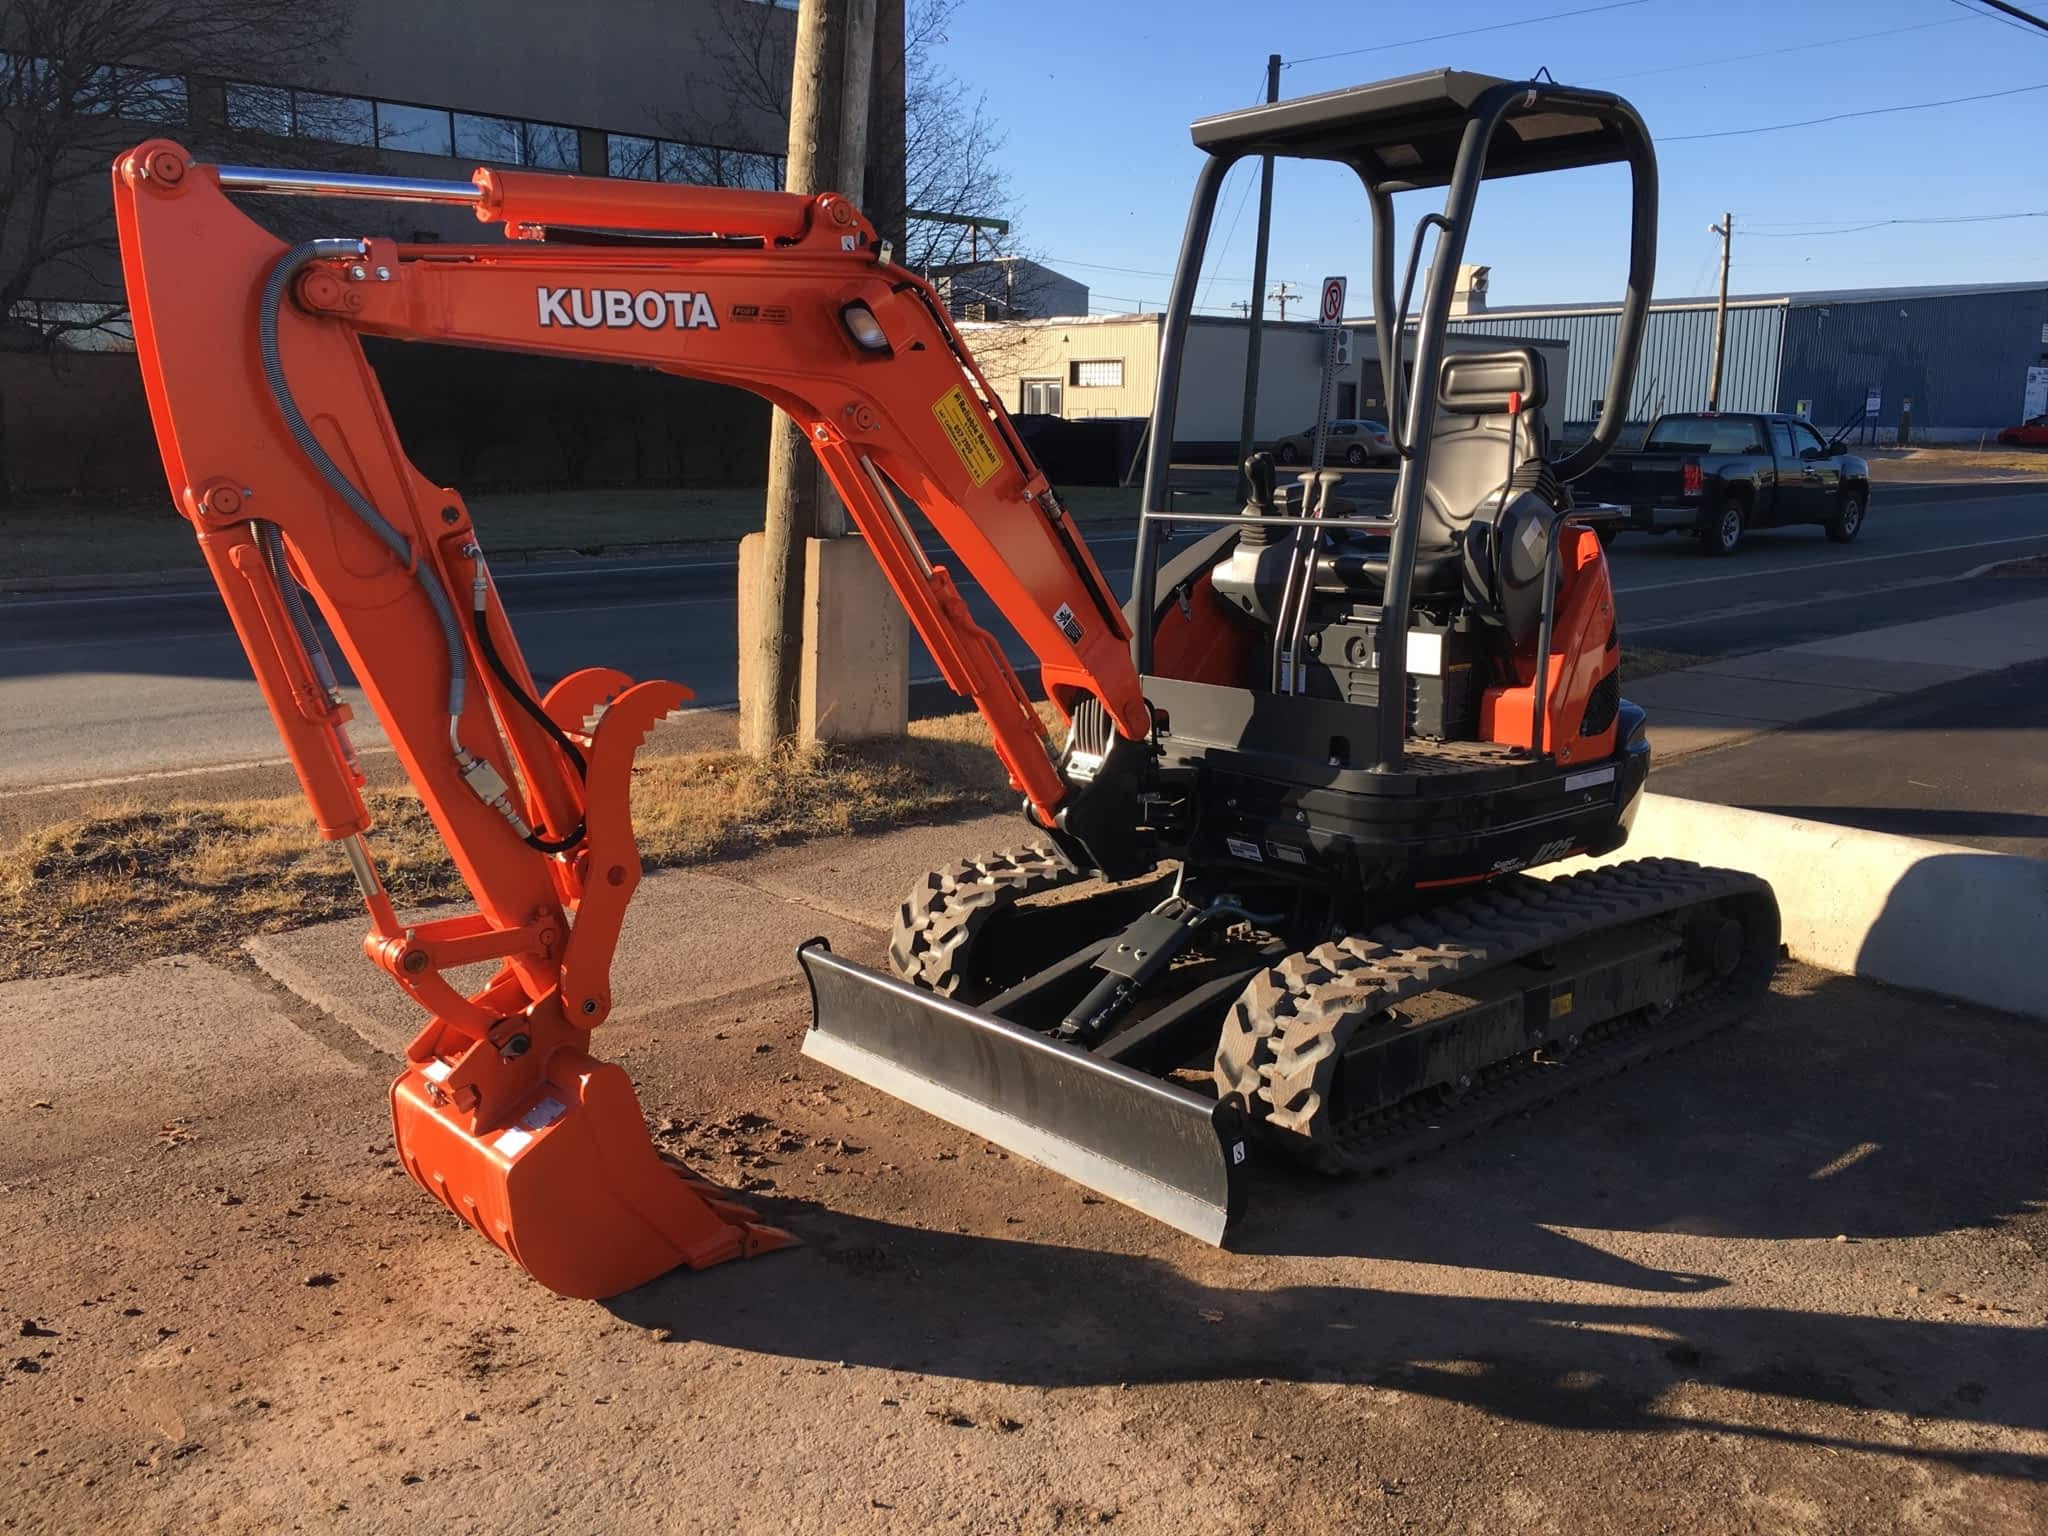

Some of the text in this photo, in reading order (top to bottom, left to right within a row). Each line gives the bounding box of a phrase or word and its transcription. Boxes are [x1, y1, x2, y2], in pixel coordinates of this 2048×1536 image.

[537, 287, 719, 329] KUBOTA
[958, 400, 979, 433] Reliable
[977, 432, 997, 463] Rentals
